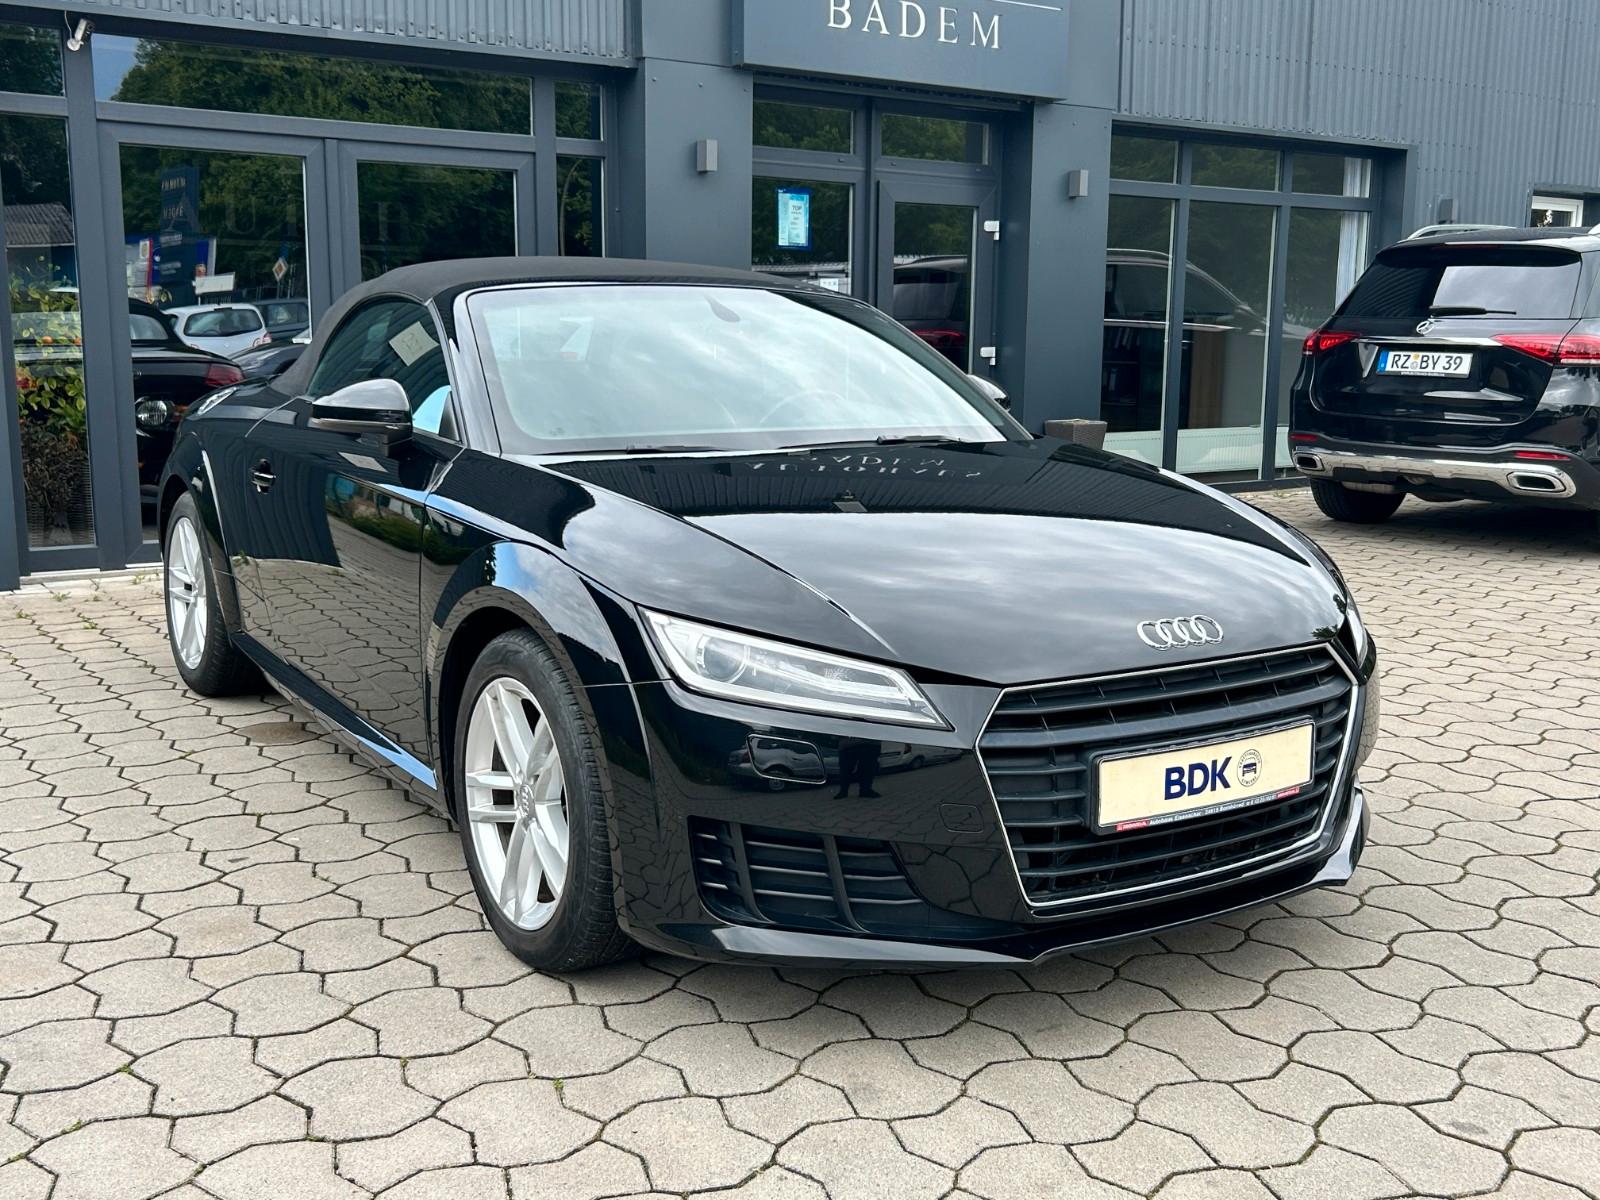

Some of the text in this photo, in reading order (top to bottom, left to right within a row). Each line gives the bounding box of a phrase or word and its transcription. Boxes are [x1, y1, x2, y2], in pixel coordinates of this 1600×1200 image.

[827, 0, 1001, 49] BADEM
[1391, 354, 1463, 371] RZ BY 39
[1165, 757, 1231, 800] BDK
